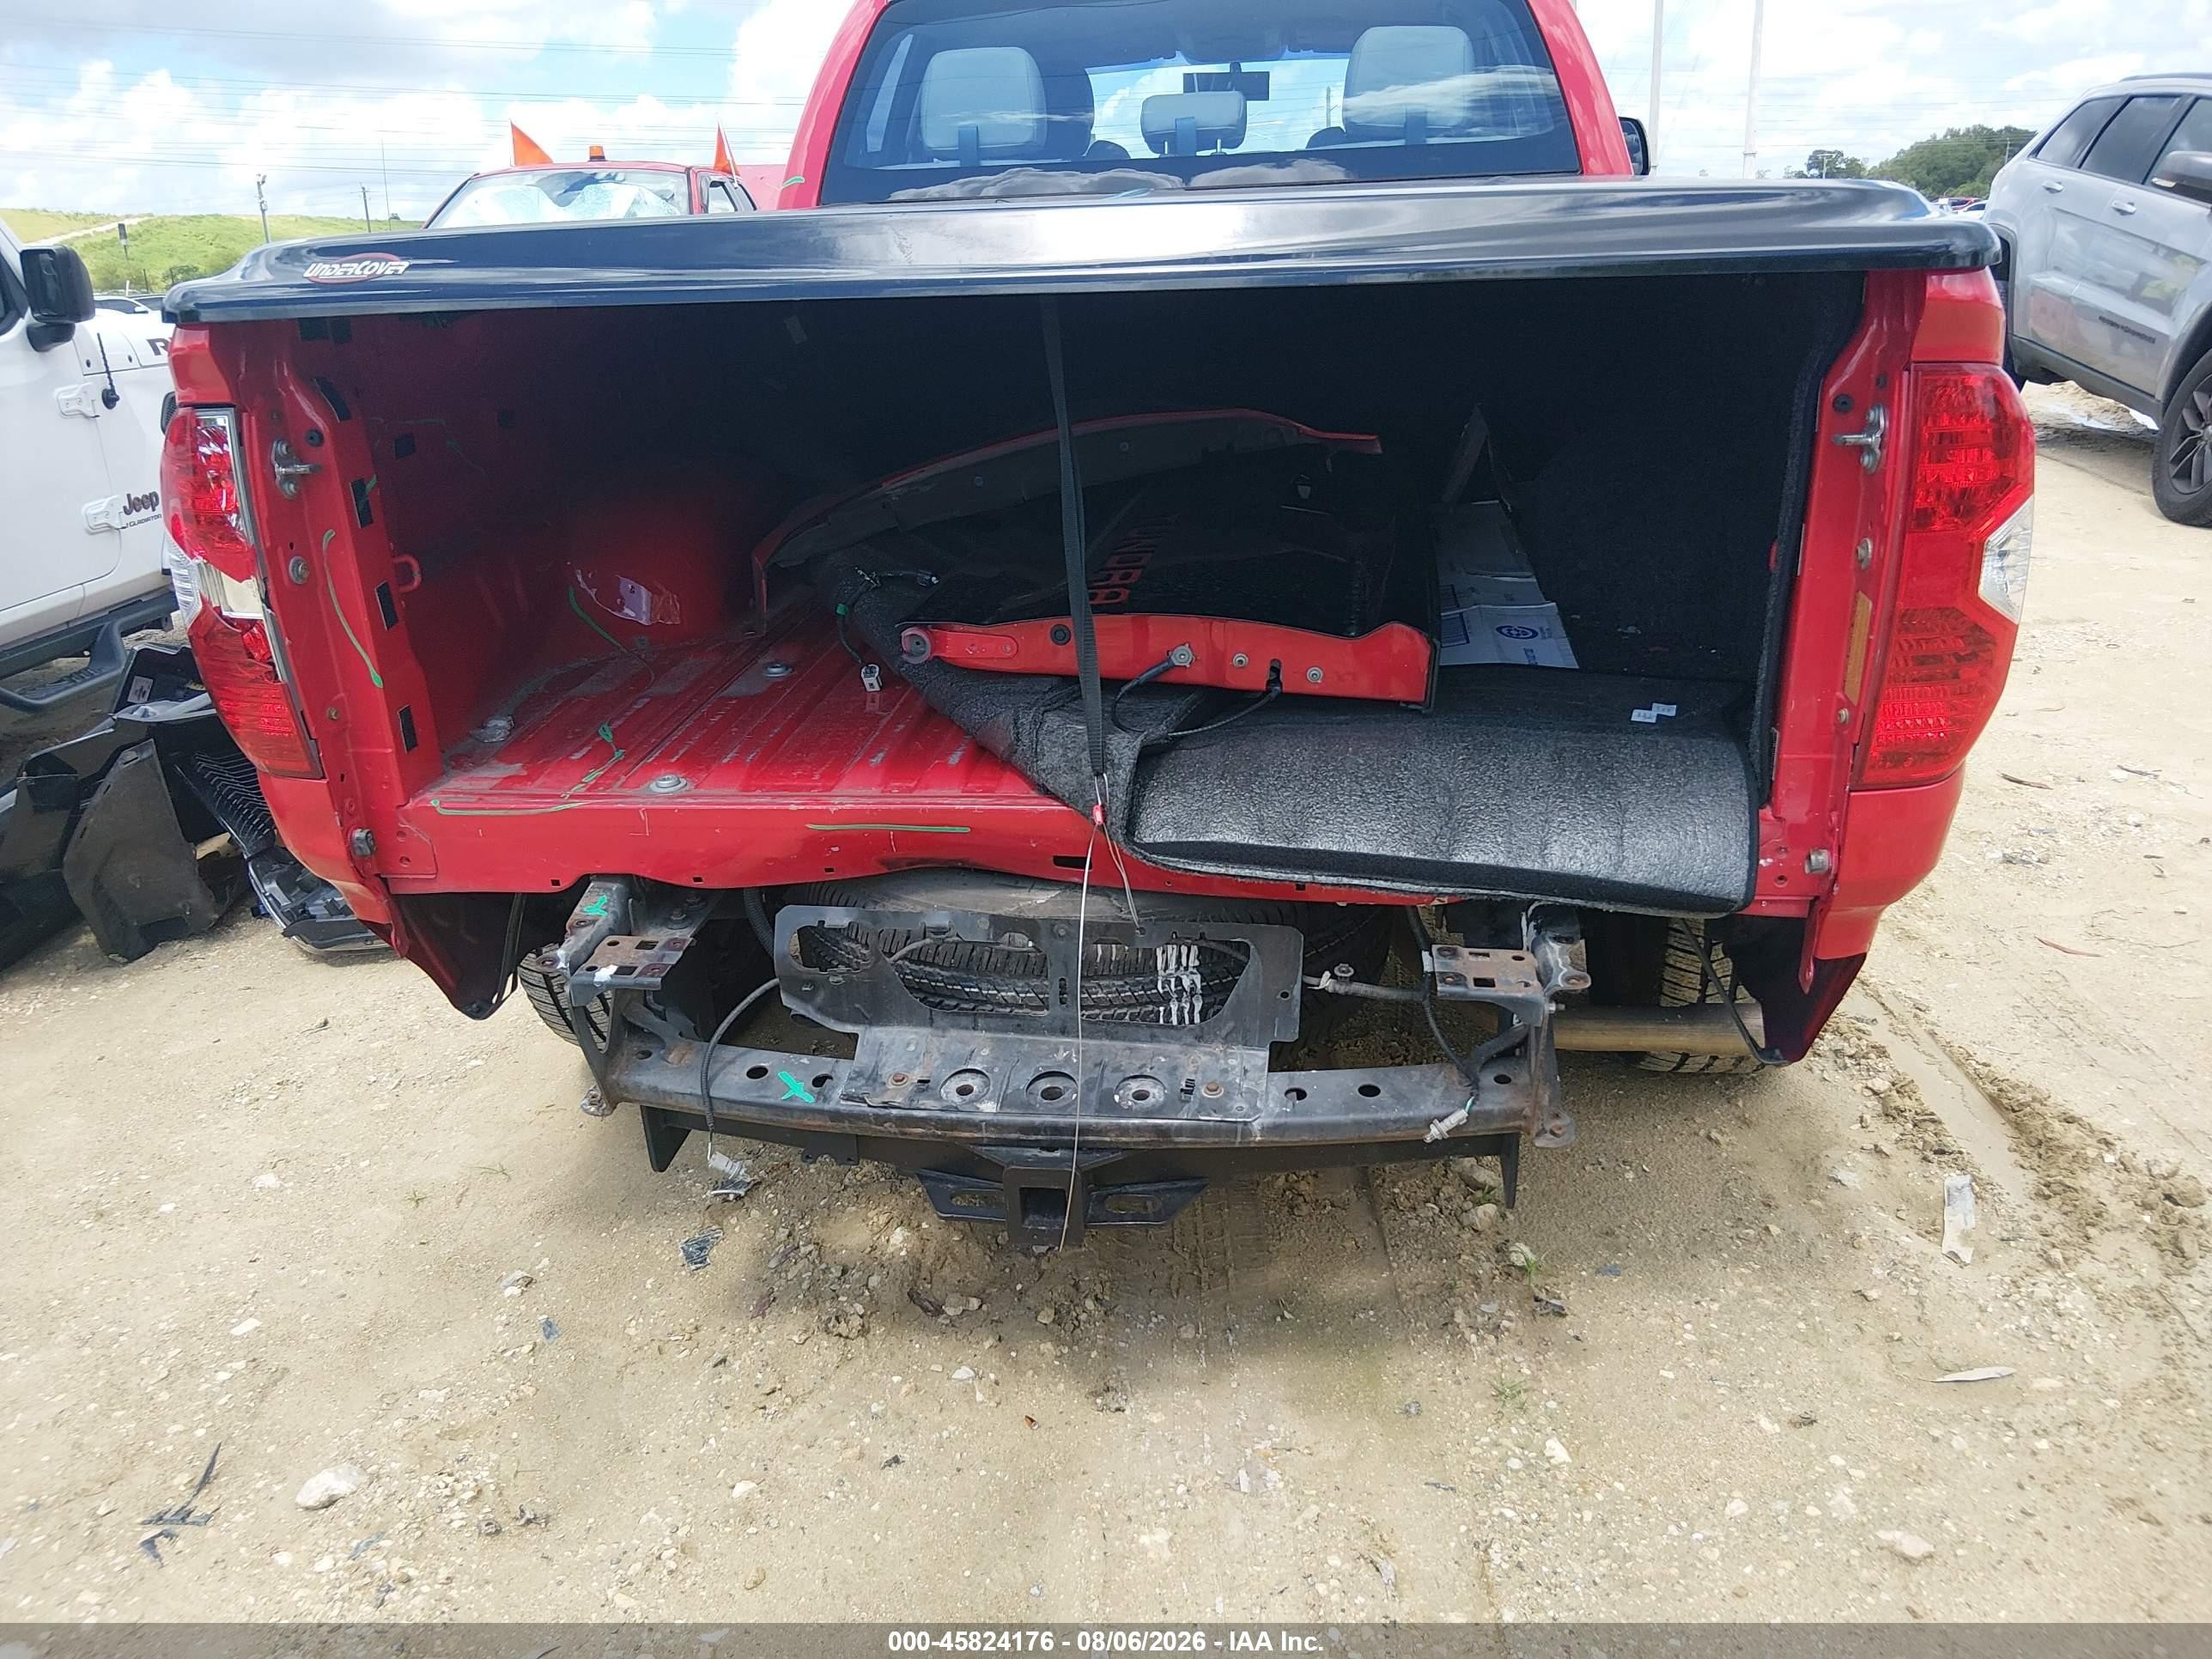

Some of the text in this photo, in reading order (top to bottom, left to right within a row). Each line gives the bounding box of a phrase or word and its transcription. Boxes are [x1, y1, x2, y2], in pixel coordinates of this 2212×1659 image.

[303, 260, 411, 278] UNDERCOVER
[146, 337, 170, 356] R
[123, 491, 160, 515] Jeep
